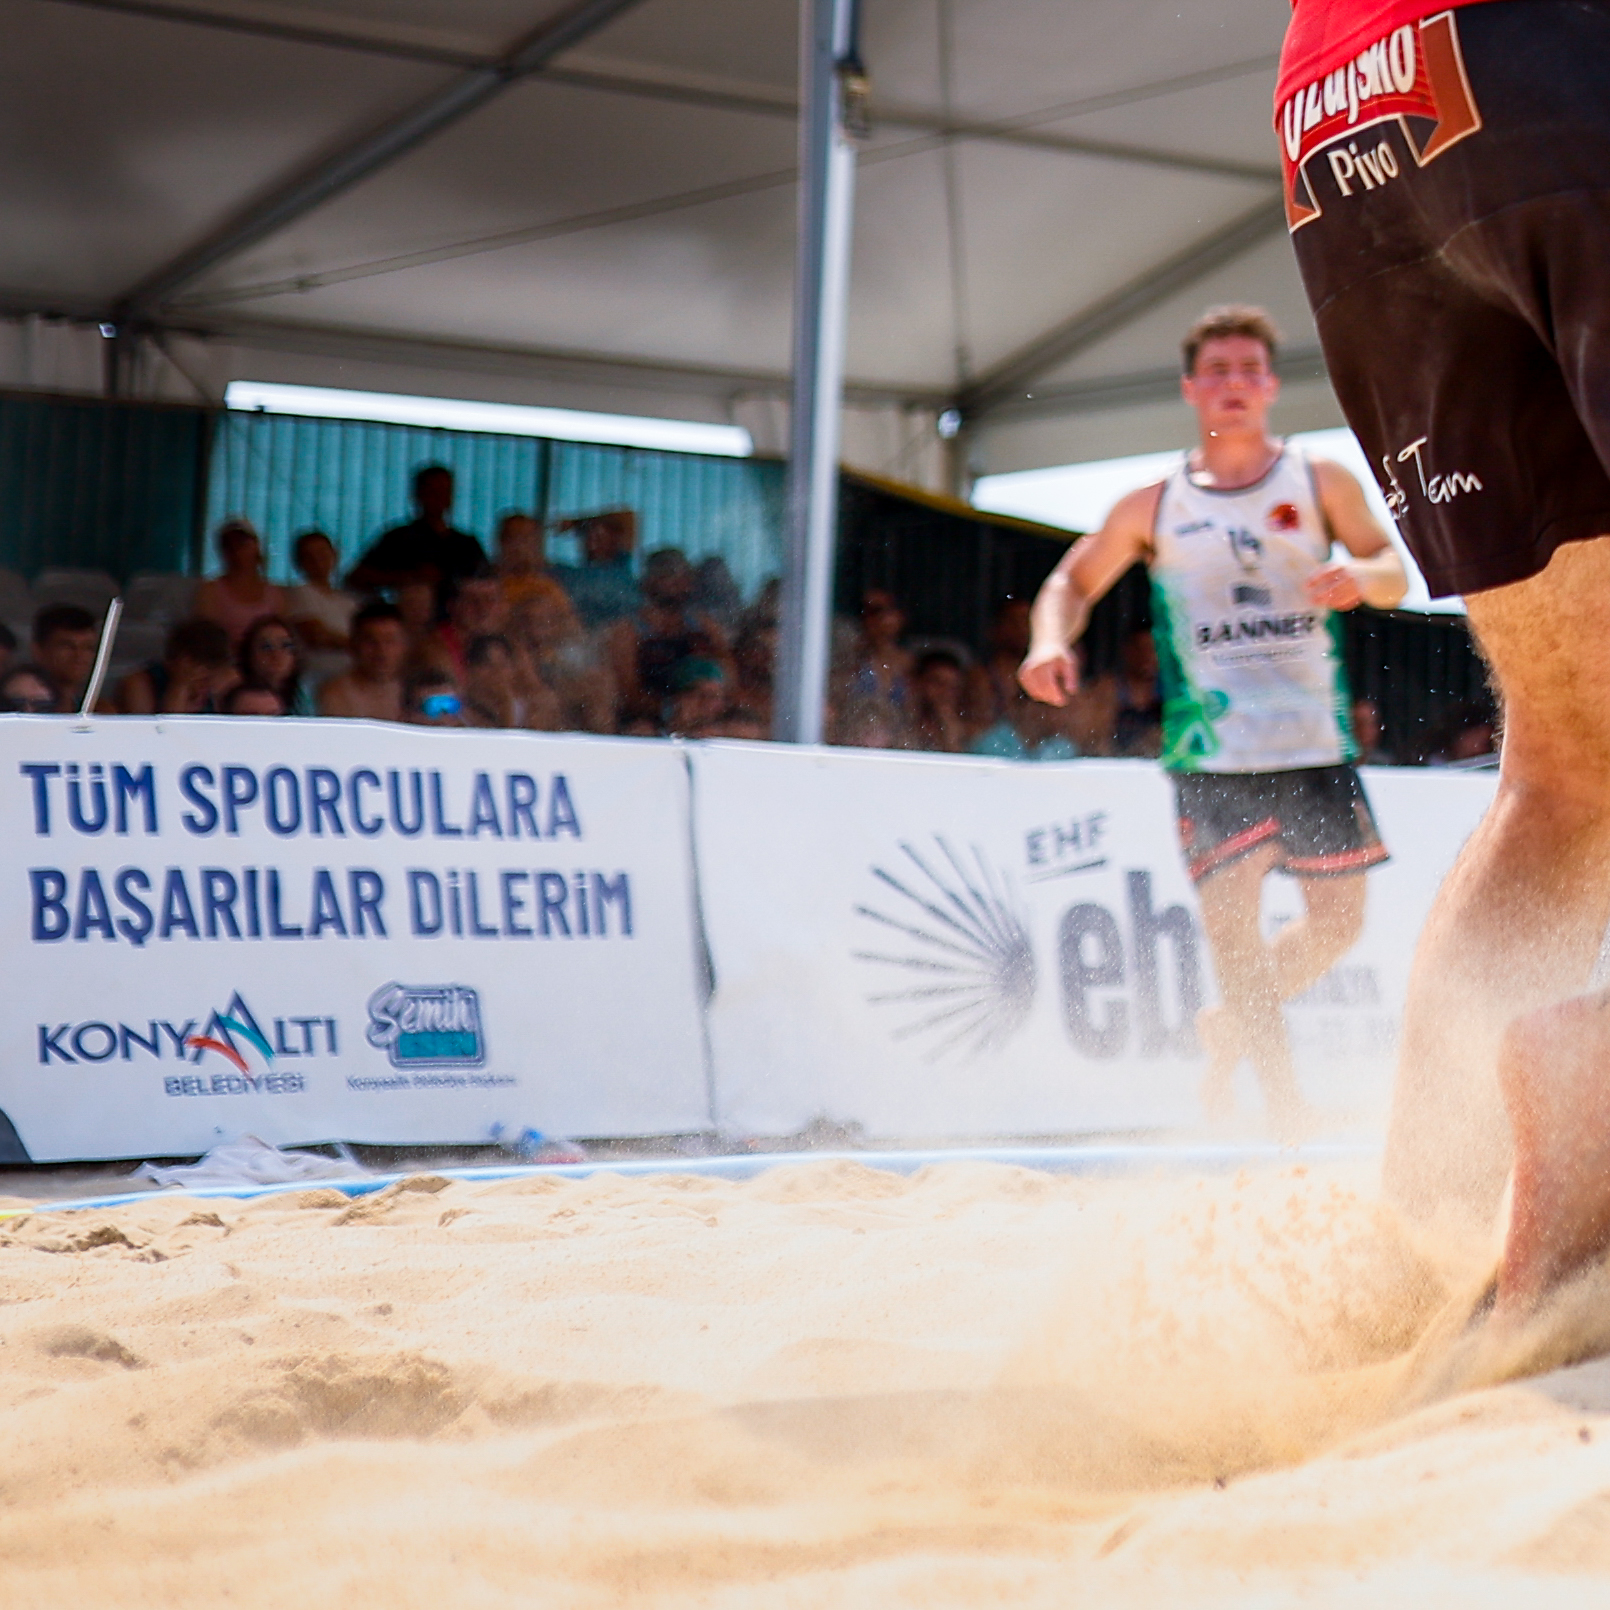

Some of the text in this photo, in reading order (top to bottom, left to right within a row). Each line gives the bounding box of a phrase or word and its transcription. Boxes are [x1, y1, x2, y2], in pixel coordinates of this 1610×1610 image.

[1326, 141, 1400, 197] Pivo
[20, 762, 582, 841] TÜM SPORCULARA
[1024, 809, 1109, 866] EHF
[28, 866, 635, 948] BAŞARILAR DİLERİM
[1056, 867, 1204, 1061] eh
